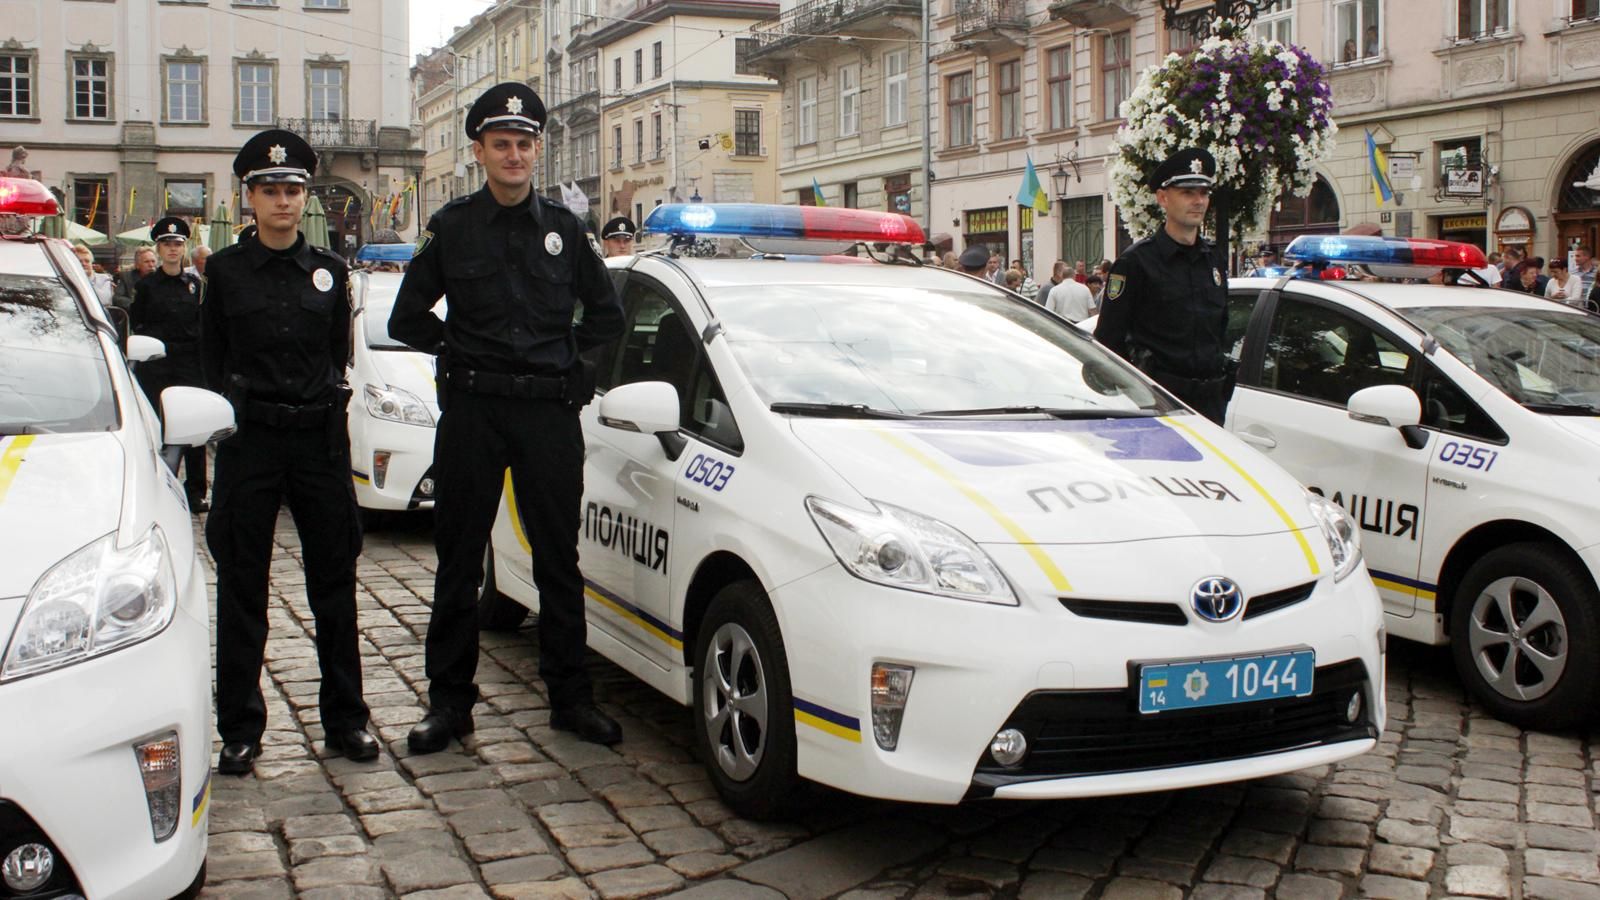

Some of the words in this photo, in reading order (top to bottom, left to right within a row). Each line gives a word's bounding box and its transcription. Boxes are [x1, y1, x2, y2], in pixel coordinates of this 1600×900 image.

[685, 453, 735, 492] 0503
[1439, 441, 1499, 472] 0351
[585, 500, 669, 576] ПОЛІЦІЯ
[1225, 657, 1297, 698] 1044
[1150, 690, 1166, 706] 14
